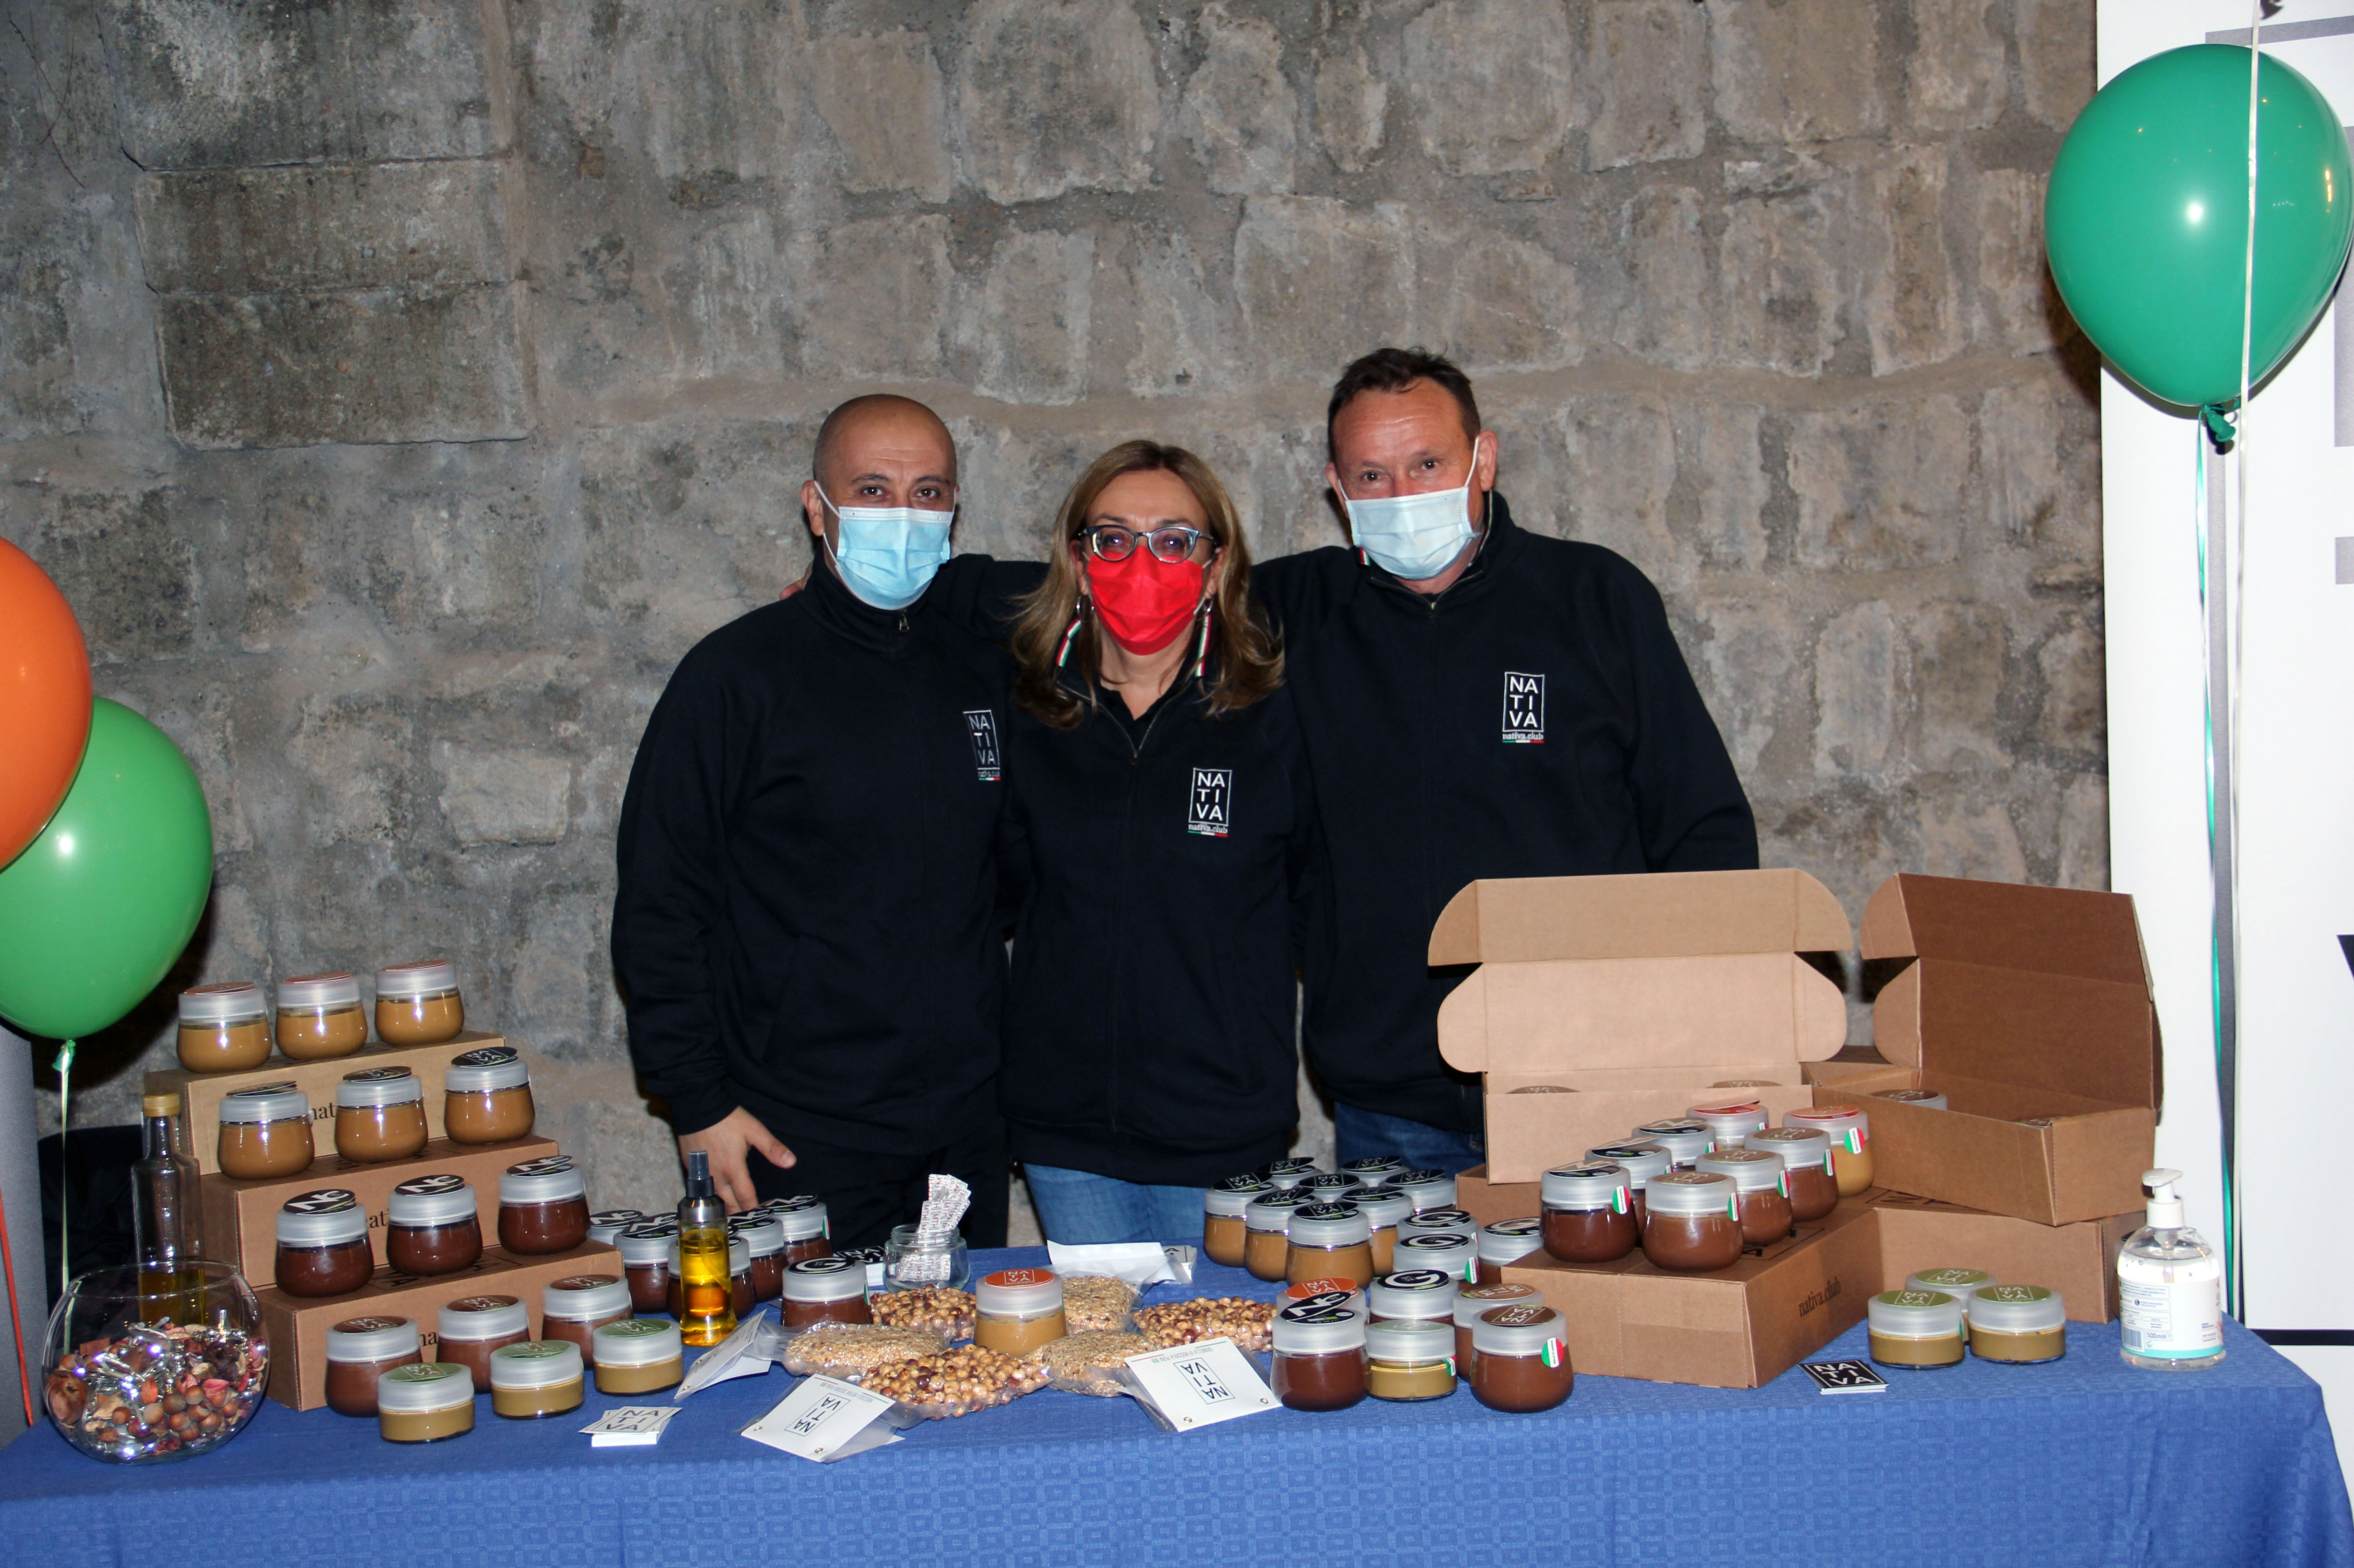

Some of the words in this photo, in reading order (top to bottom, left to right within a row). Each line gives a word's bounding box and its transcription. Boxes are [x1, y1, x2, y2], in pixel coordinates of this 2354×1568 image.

[1510, 676, 1538, 694] NA
[1509, 694, 1534, 710] TI
[969, 715, 991, 730] NA
[1509, 710, 1538, 728] VA
[974, 732, 990, 747] TI
[978, 749, 996, 764] VA
[1197, 772, 1225, 788] NA
[1197, 789, 1219, 803] TI
[1196, 803, 1223, 821] VA
[1188, 824, 1228, 833] nativa.club
[1799, 1276, 1840, 1317] nativa.club
[1181, 1362, 1208, 1374] VA
[1813, 1363, 1858, 1372] NA
[1202, 1386, 1229, 1399] NA
[821, 1397, 841, 1410] VA
[794, 1419, 816, 1432] NA
